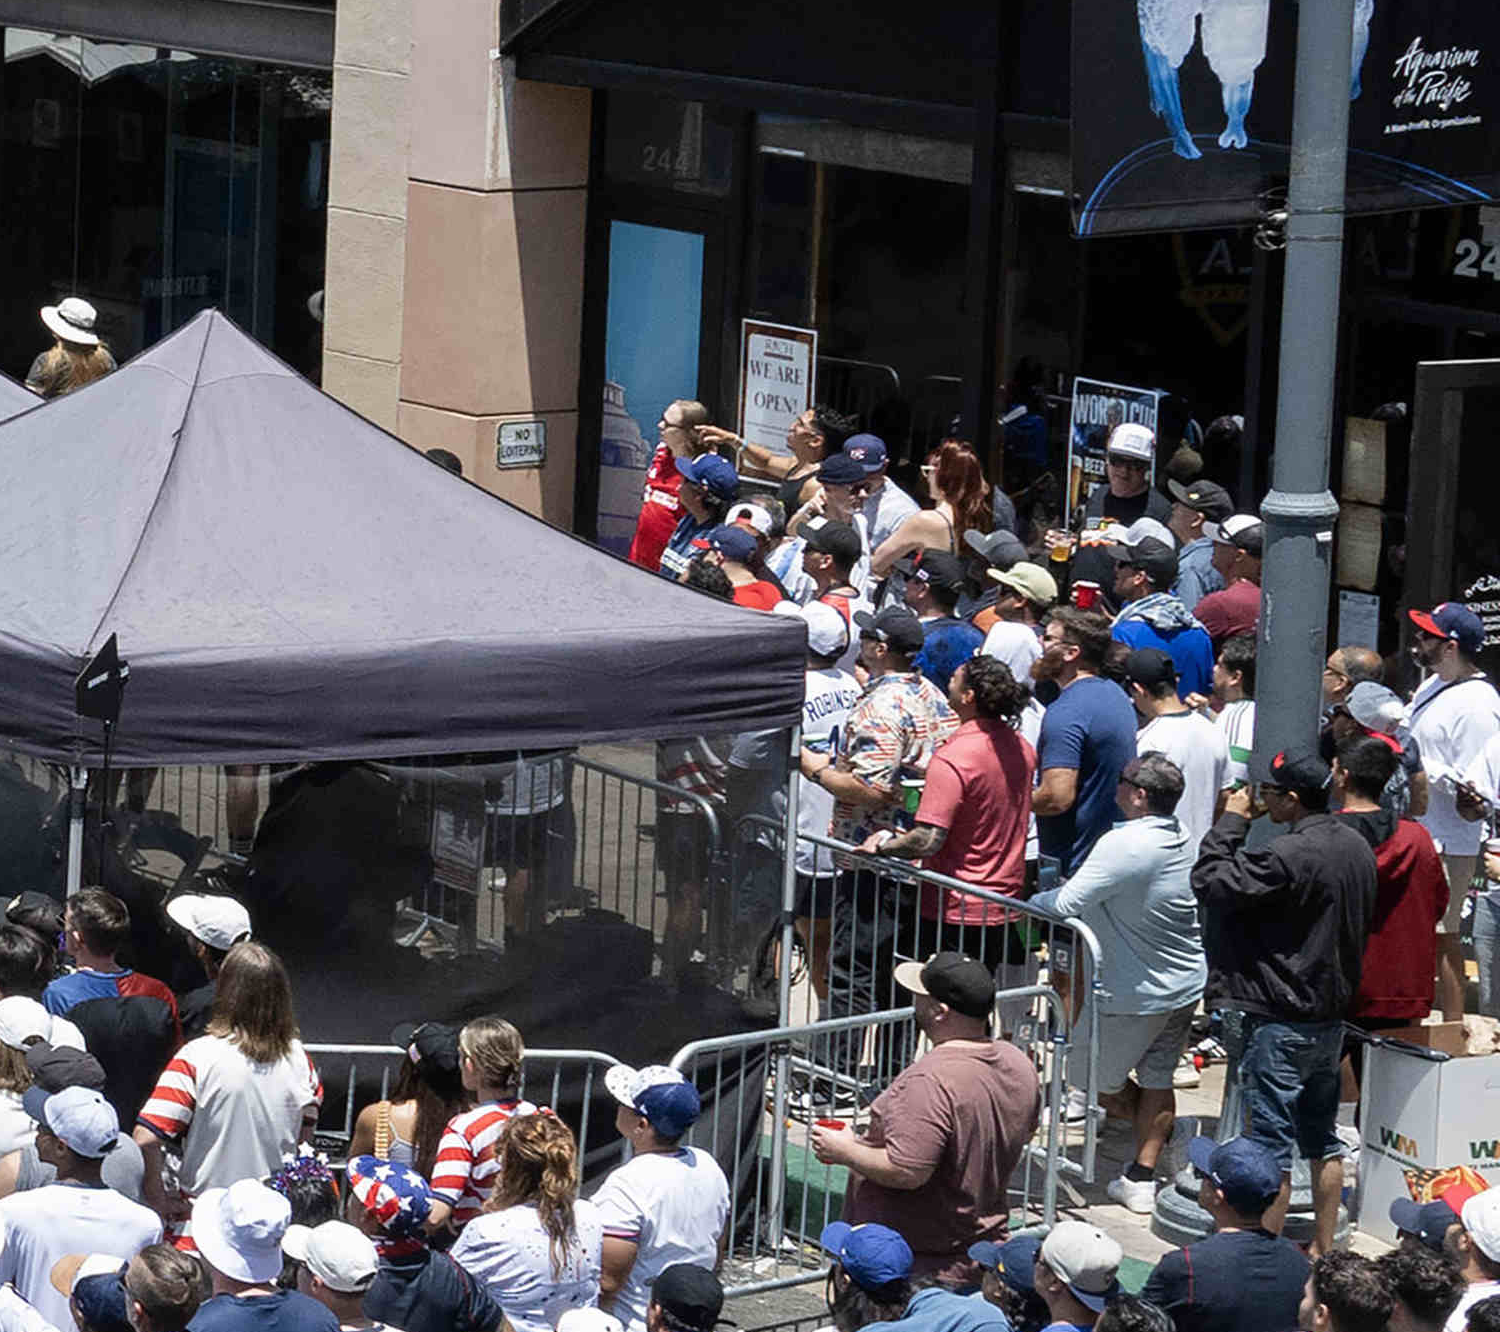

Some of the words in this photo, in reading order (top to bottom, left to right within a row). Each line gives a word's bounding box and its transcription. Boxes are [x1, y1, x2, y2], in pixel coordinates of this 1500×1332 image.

[750, 359, 776, 381] WE
[777, 365, 804, 386] ARE
[515, 429, 530, 442] NO
[1380, 1125, 1420, 1159] WM
